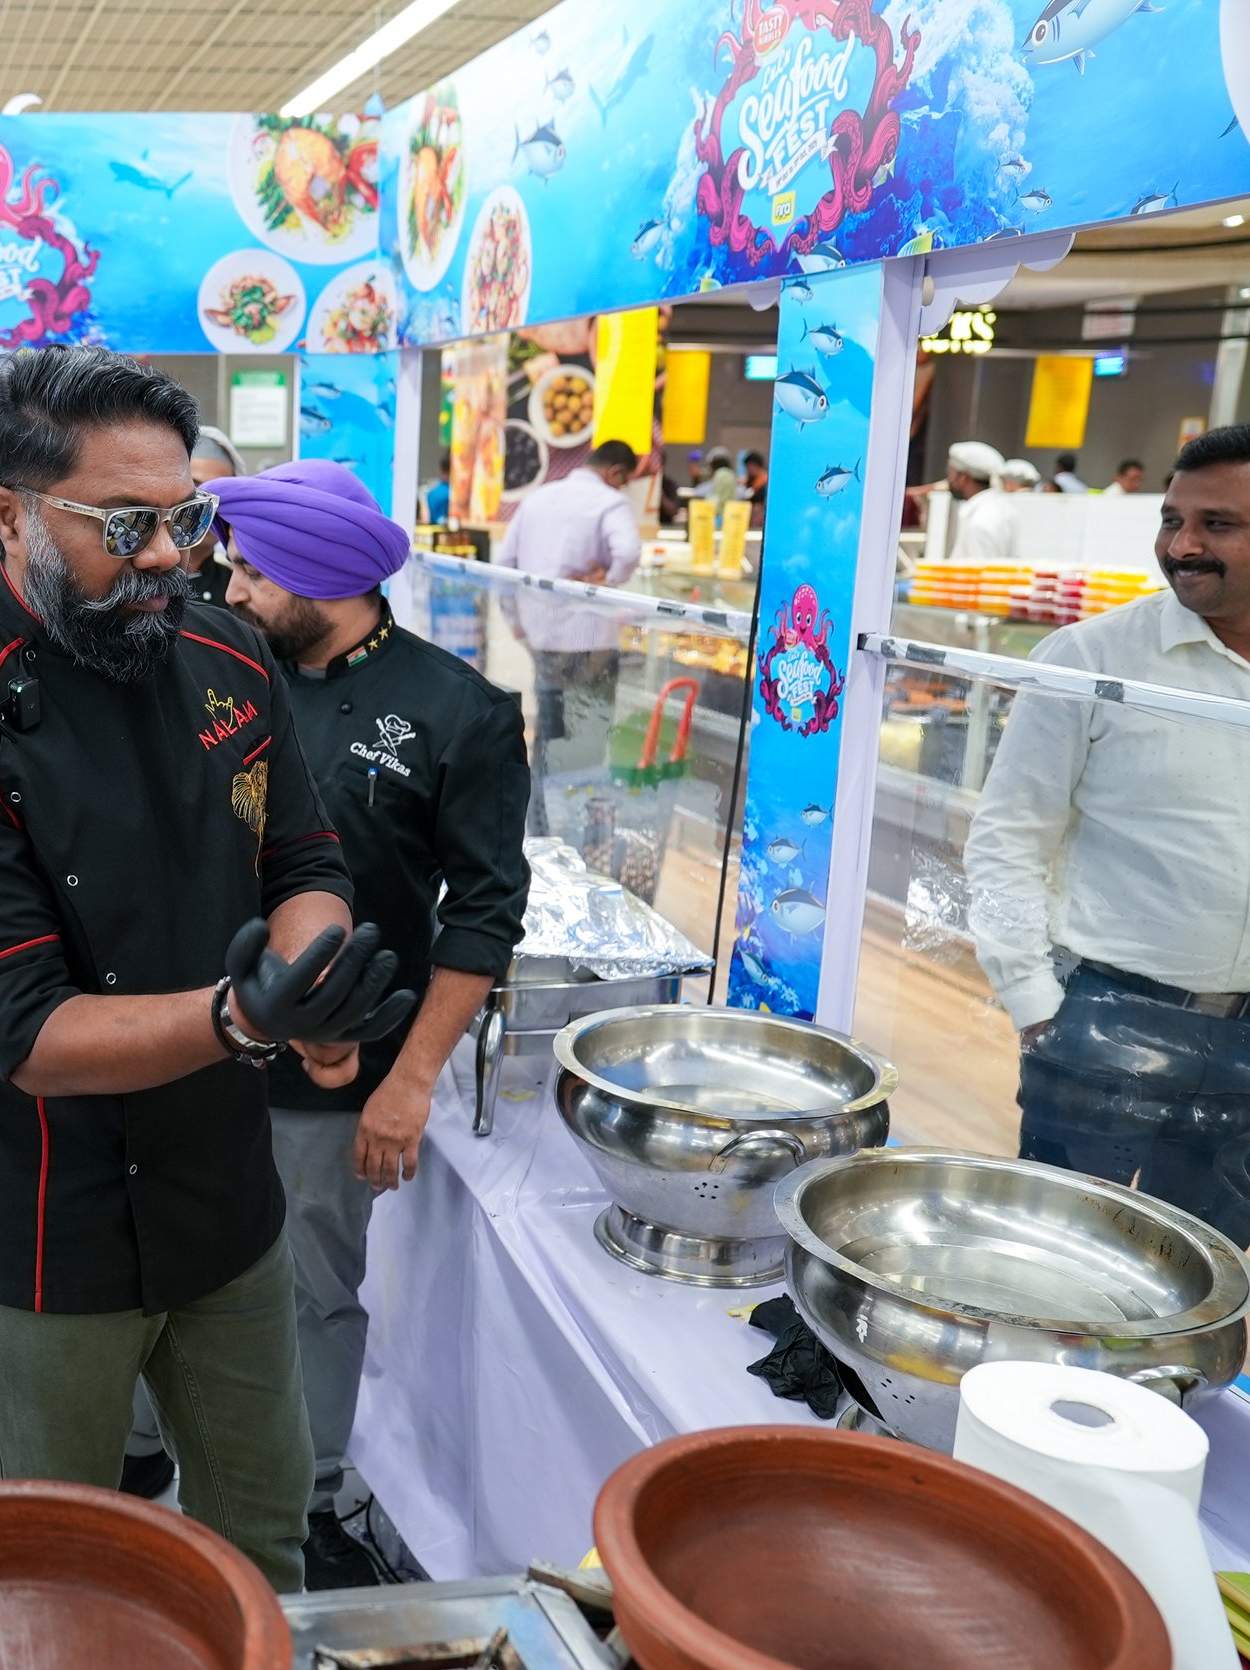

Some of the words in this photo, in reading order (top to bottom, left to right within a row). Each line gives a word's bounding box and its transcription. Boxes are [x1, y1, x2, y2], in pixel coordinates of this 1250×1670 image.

[759, 14, 783, 37] TASTY
[738, 29, 855, 190] Seafood
[772, 98, 830, 173] FEST
[777, 651, 825, 699] Seafood
[792, 680, 815, 699] FEST
[350, 741, 382, 761] Chef
[379, 752, 412, 777] Vikas
